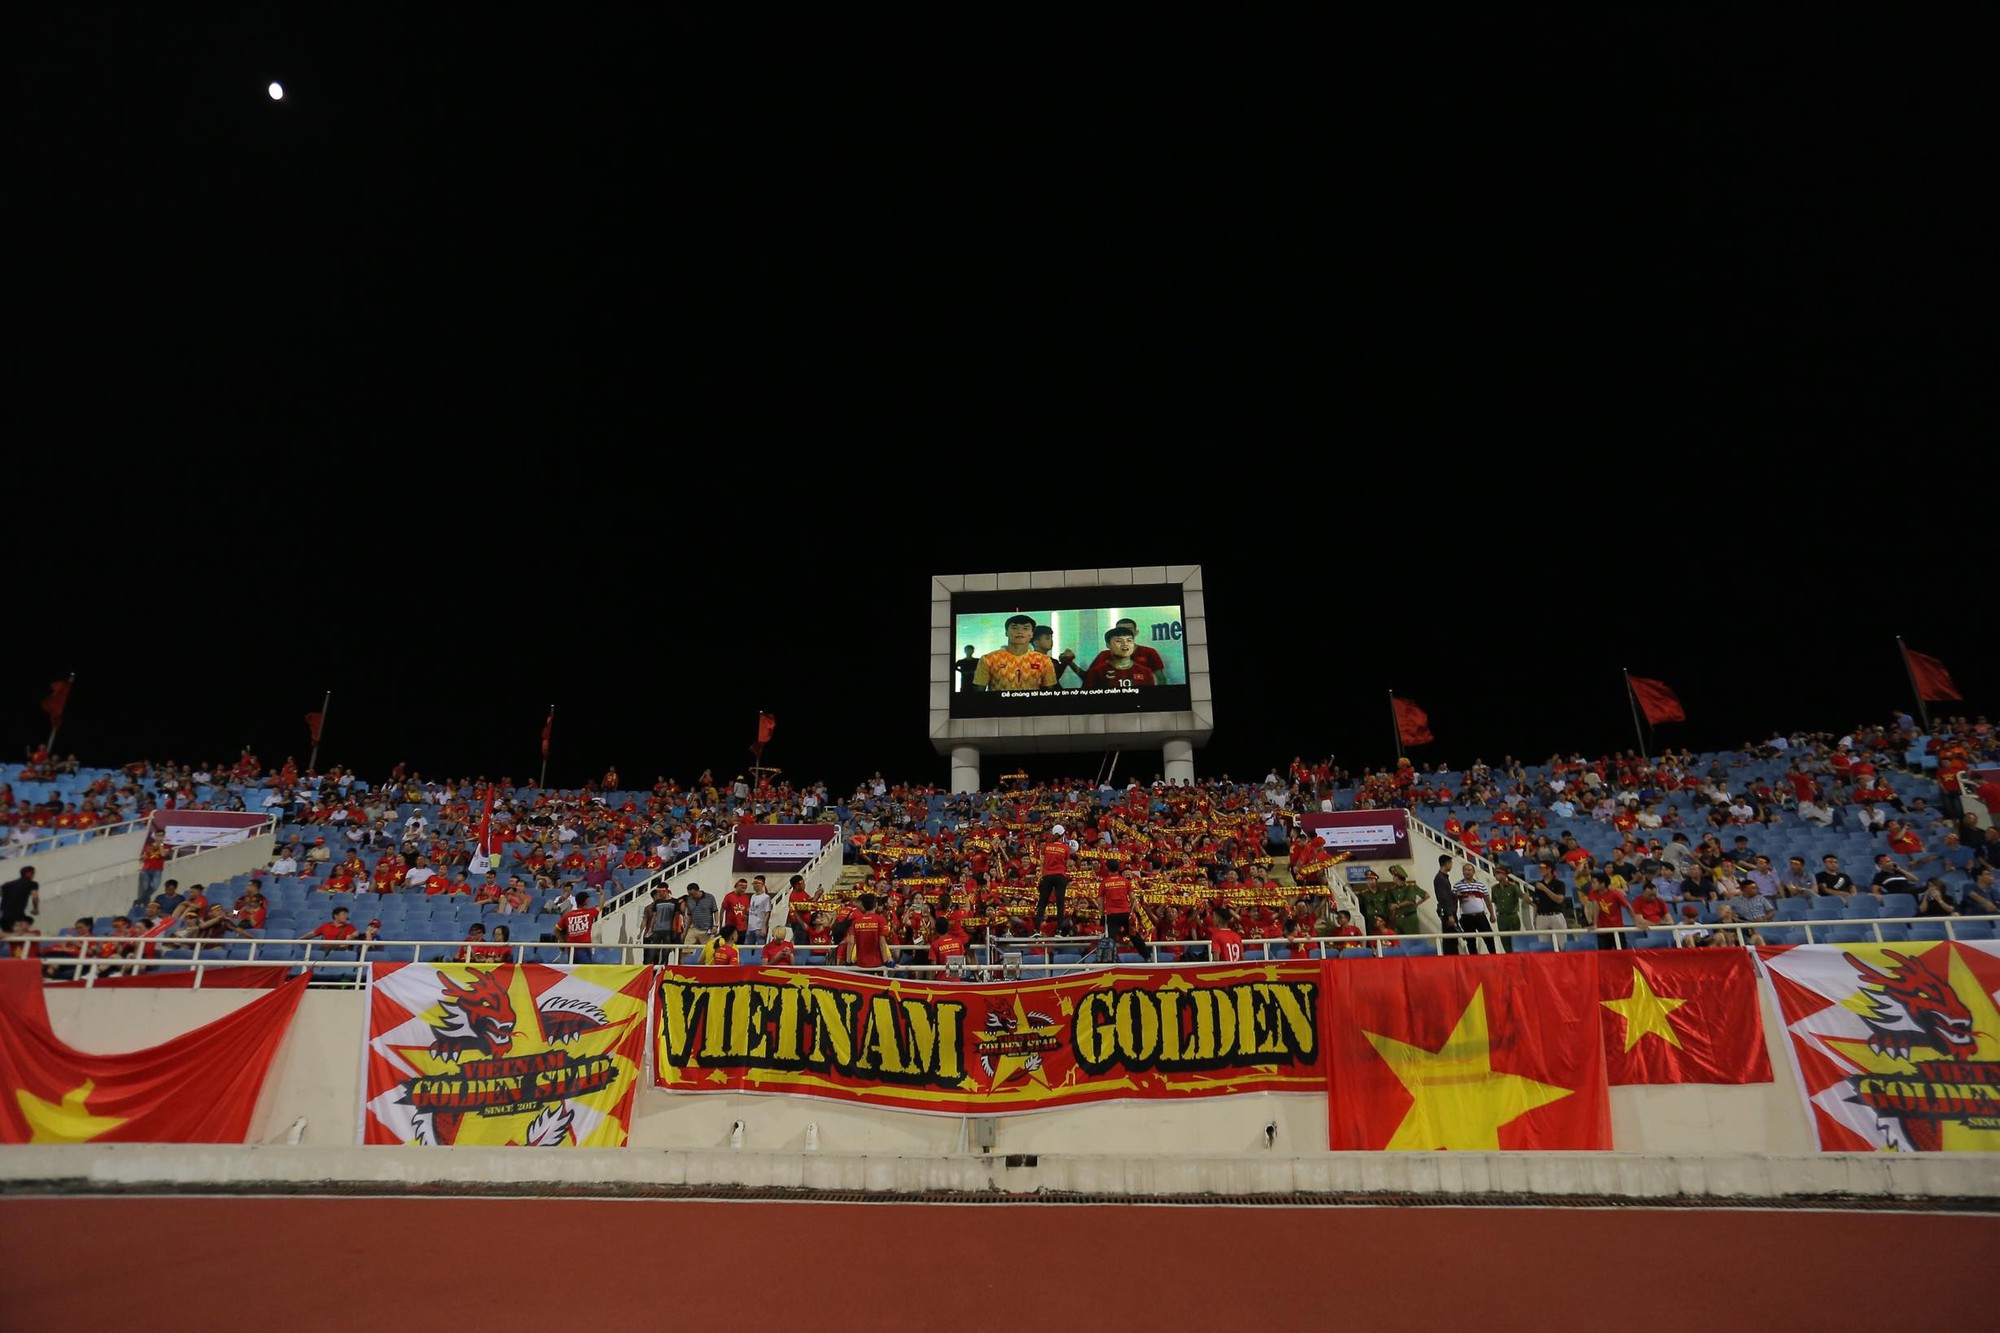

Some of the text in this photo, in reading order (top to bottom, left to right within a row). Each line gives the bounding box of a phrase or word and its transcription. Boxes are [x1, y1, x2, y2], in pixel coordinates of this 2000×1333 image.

[1151, 620, 1182, 641] me
[568, 914, 590, 925] VIET
[568, 922, 589, 932] NAM
[661, 982, 1313, 1079] VIETNAM GOLDEN
[463, 1052, 566, 1079] VIETNAM
[411, 1058, 611, 1107] GOLDEN STAR
[484, 1101, 538, 1115] SINCE 2017
